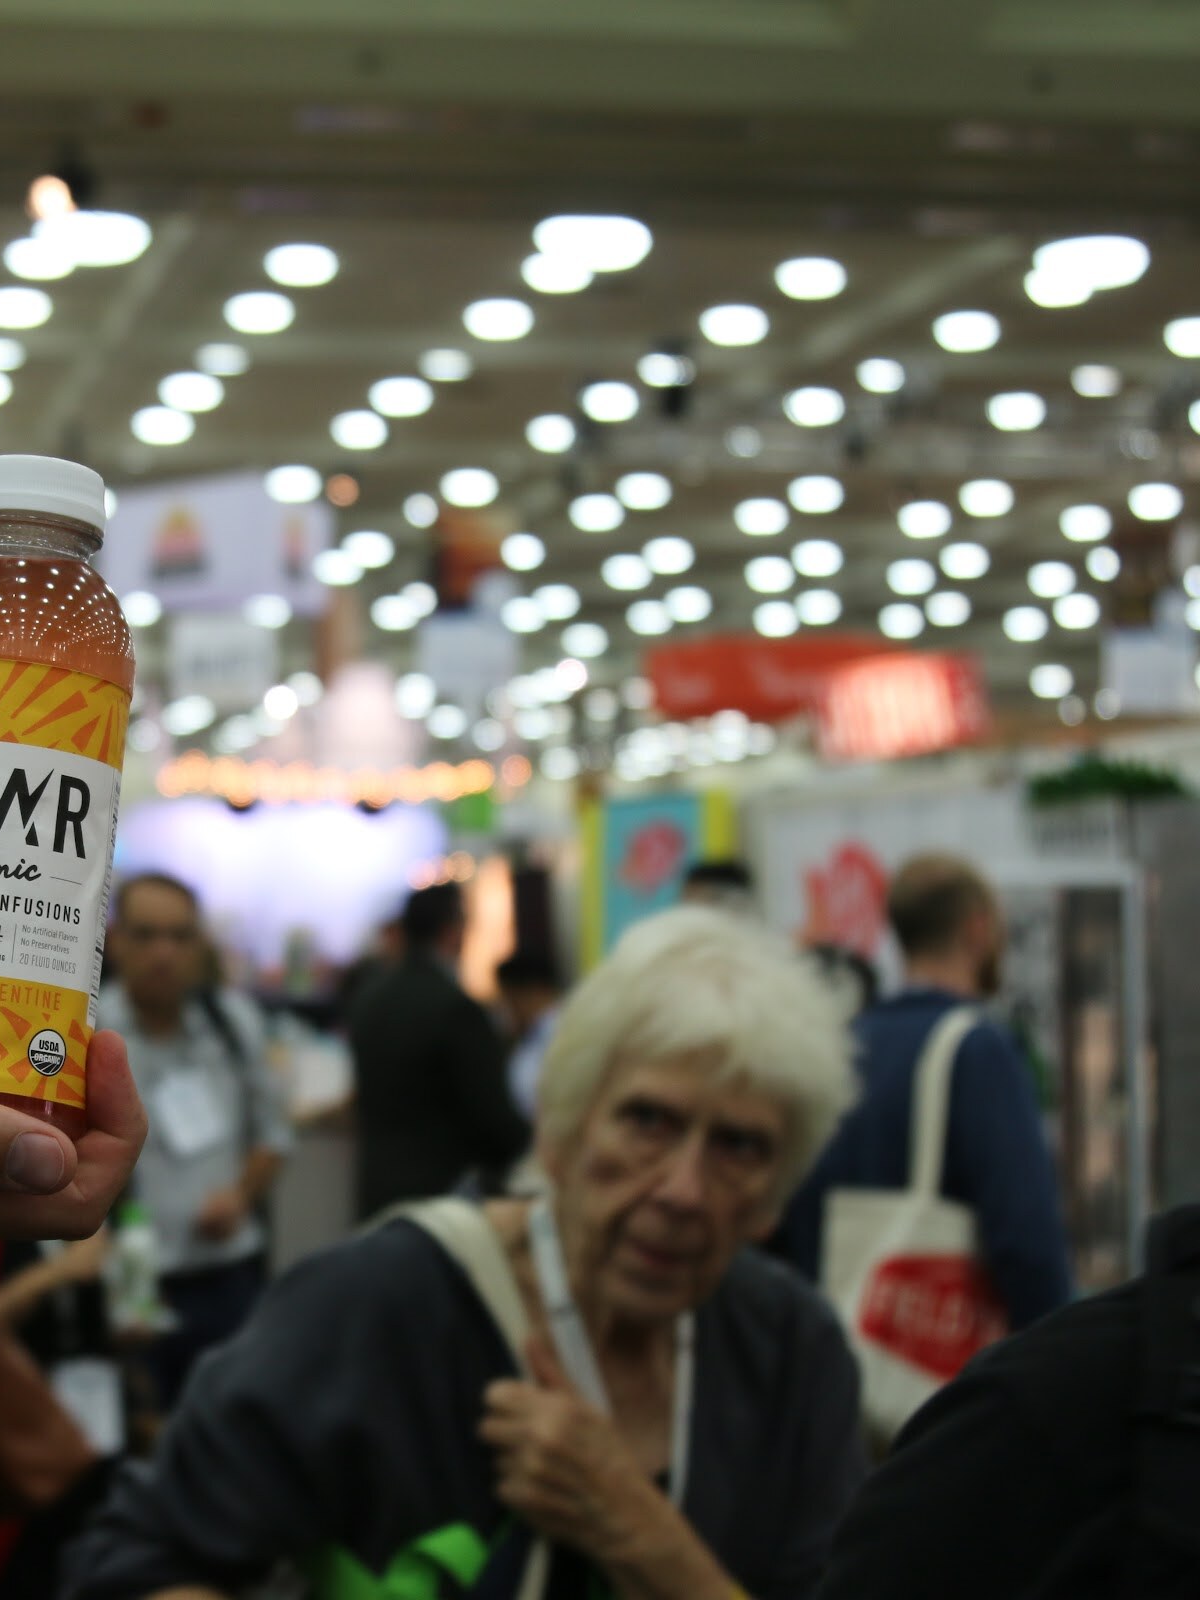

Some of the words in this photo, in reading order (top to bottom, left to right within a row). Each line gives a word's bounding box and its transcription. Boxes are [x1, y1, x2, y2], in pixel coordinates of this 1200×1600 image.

[22, 924, 31, 933] No
[33, 927, 57, 938] Artificial
[59, 932, 78, 943] Flavors
[21, 938, 30, 946] No
[31, 939, 69, 954] Preservatives
[19, 953, 29, 965] 20
[31, 955, 50, 968] FLUID
[51, 958, 76, 974] OUNCES
[38, 1040, 59, 1053] USDA
[34, 1053, 61, 1065] ORGANIC
